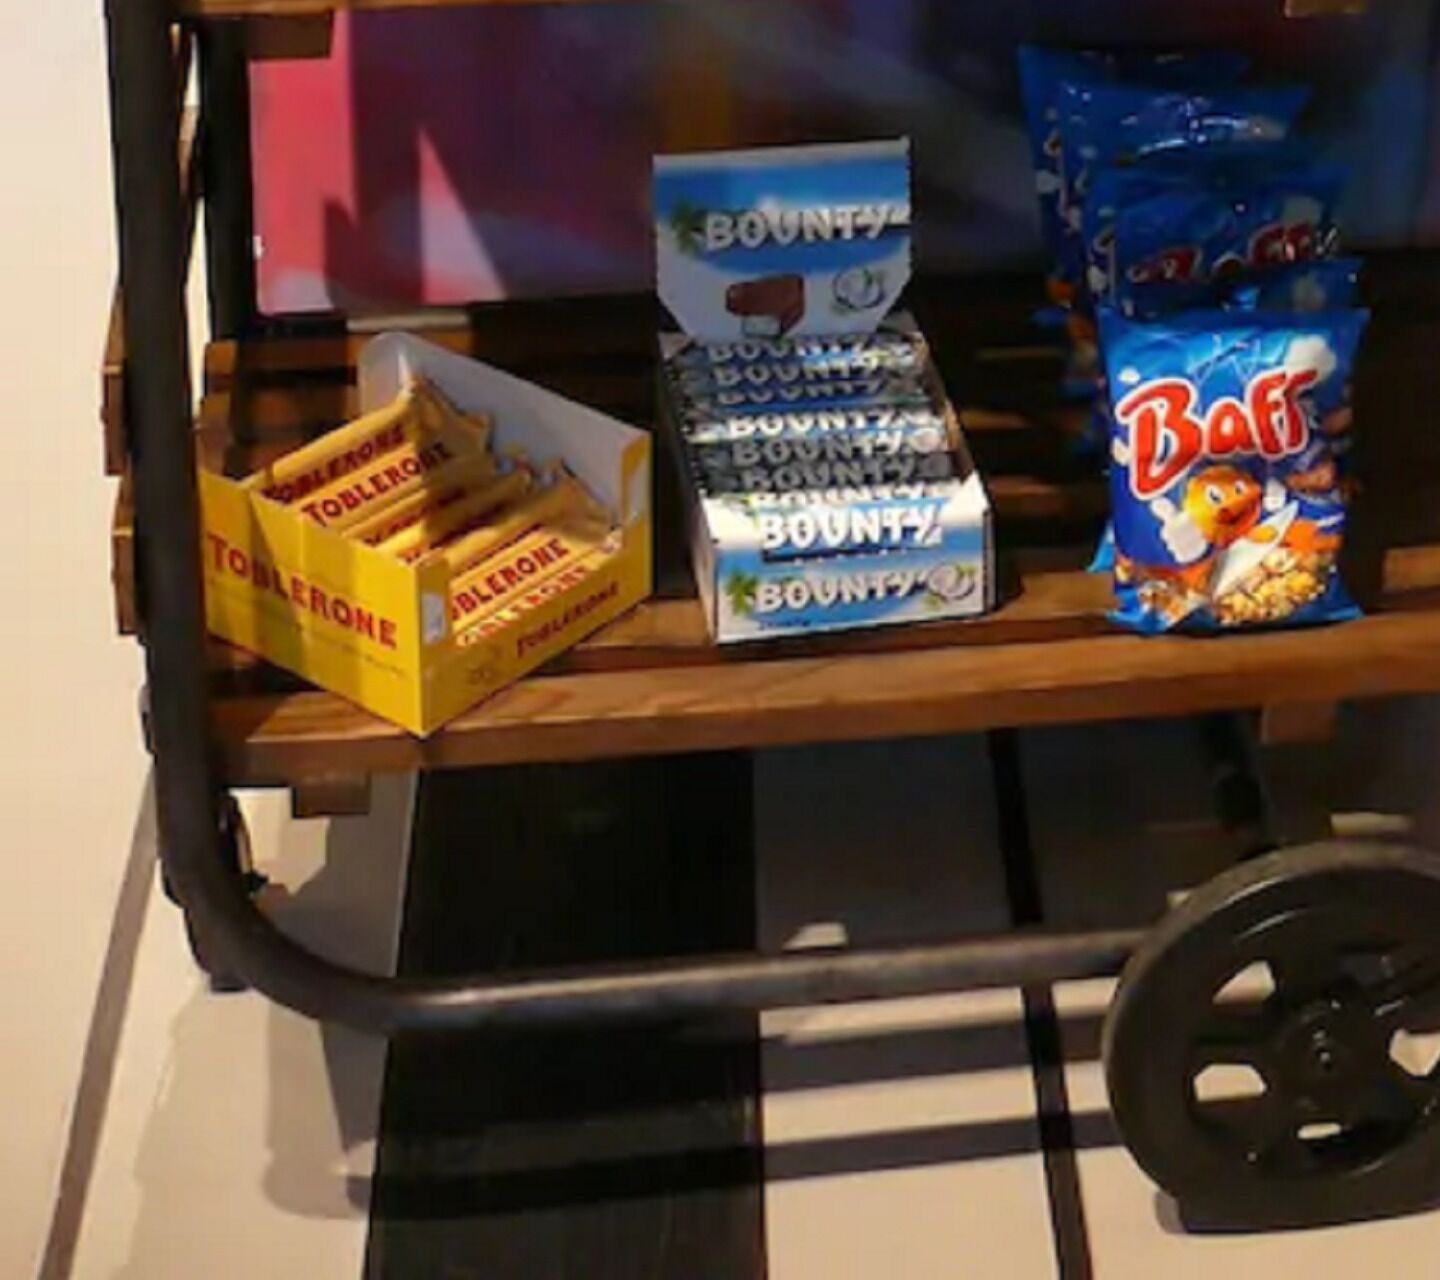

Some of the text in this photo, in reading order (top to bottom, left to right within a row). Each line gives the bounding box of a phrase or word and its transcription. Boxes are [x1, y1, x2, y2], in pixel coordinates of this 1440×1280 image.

[705, 204, 888, 250] BOUNTY
[726, 407, 896, 437] BOUNTY
[1116, 365, 1324, 502] Baff
[732, 430, 903, 468] BOUNTY
[302, 440, 452, 528] TOBLERONE
[761, 502, 935, 550] BOUNTY
[206, 530, 398, 650] TOBLERONE
[756, 568, 918, 613] BOUNTY
